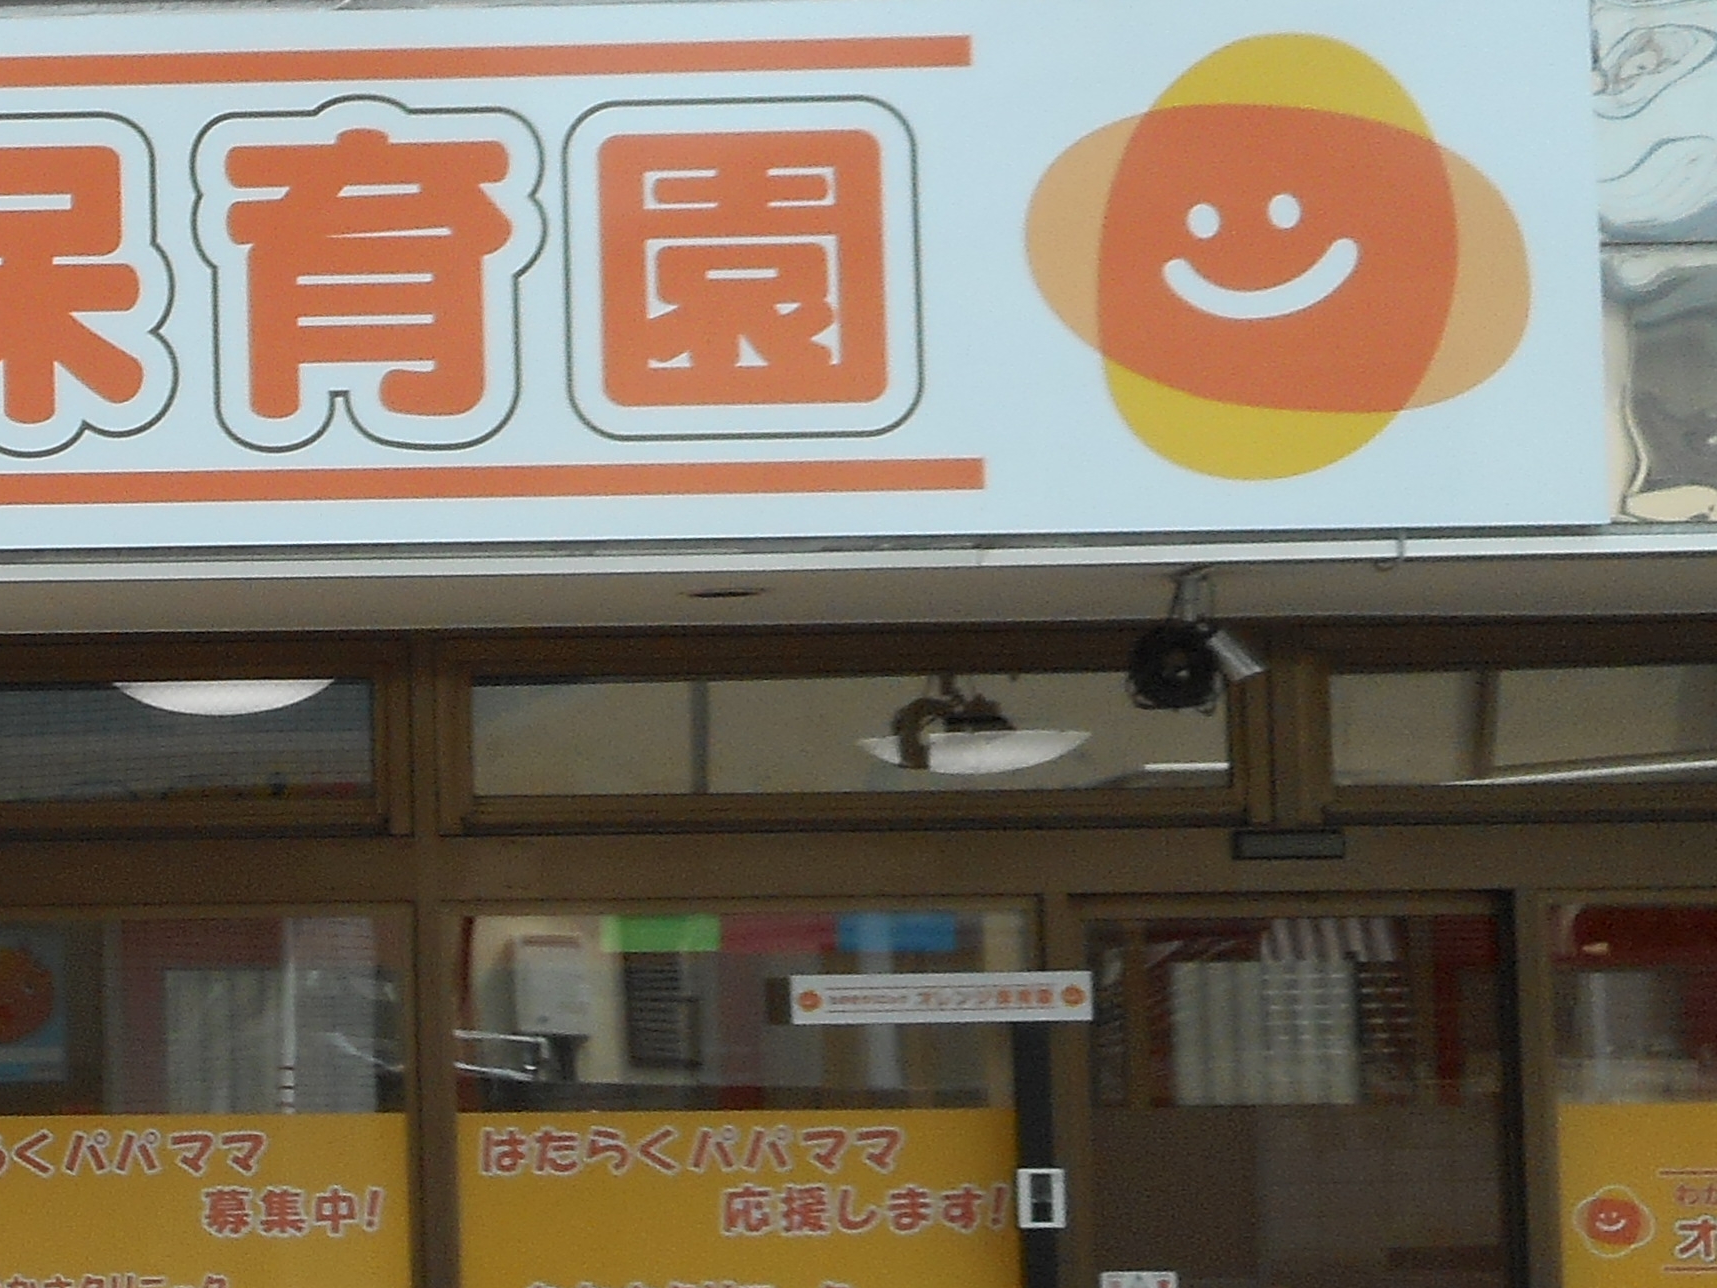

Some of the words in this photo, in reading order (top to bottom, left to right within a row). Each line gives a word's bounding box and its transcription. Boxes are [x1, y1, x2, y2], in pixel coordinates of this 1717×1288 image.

[480, 1125, 905, 1175] はたらくパパママ
[202, 1185, 385, 1237] 募集中!
[722, 1182, 1010, 1235] 応援します!
